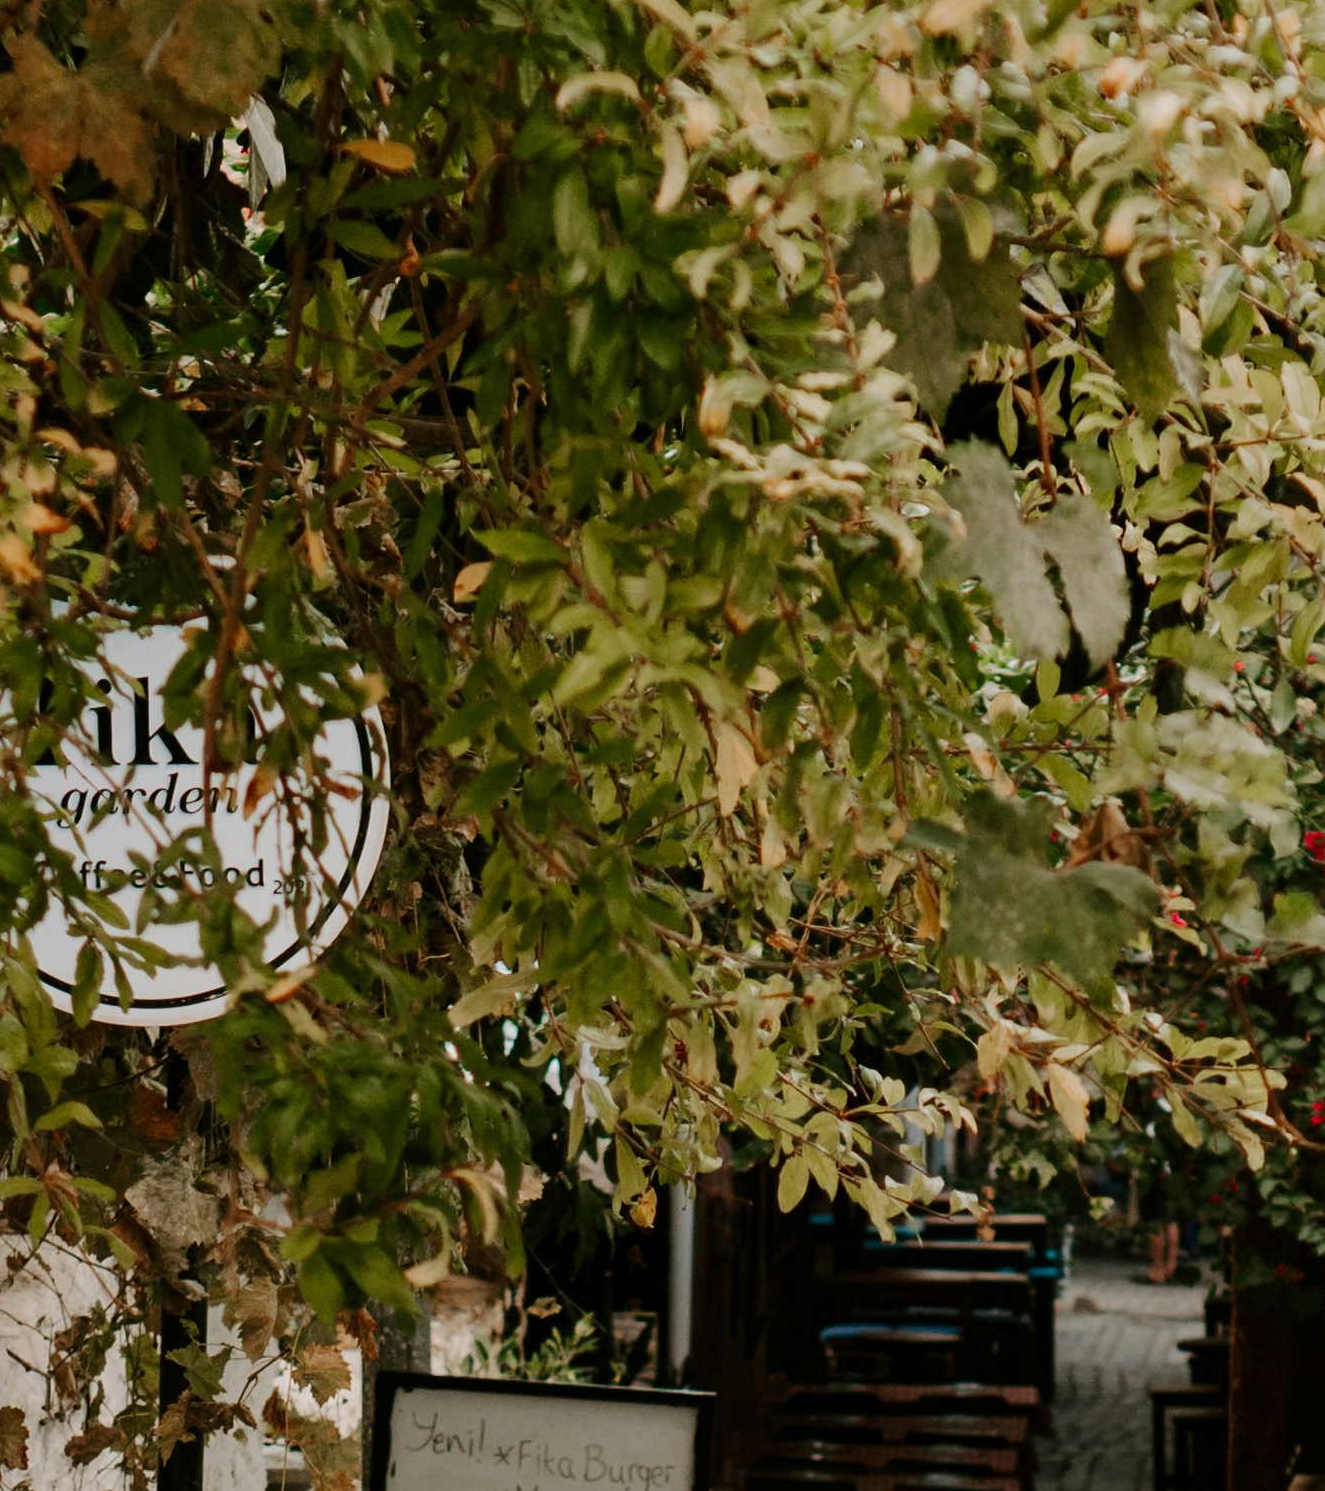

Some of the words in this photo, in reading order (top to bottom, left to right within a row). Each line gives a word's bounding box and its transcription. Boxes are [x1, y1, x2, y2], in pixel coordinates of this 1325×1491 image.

[56, 772, 239, 829] garden
[406, 1412, 487, 1464] Yeni!
[517, 1440, 576, 1480] Fika
